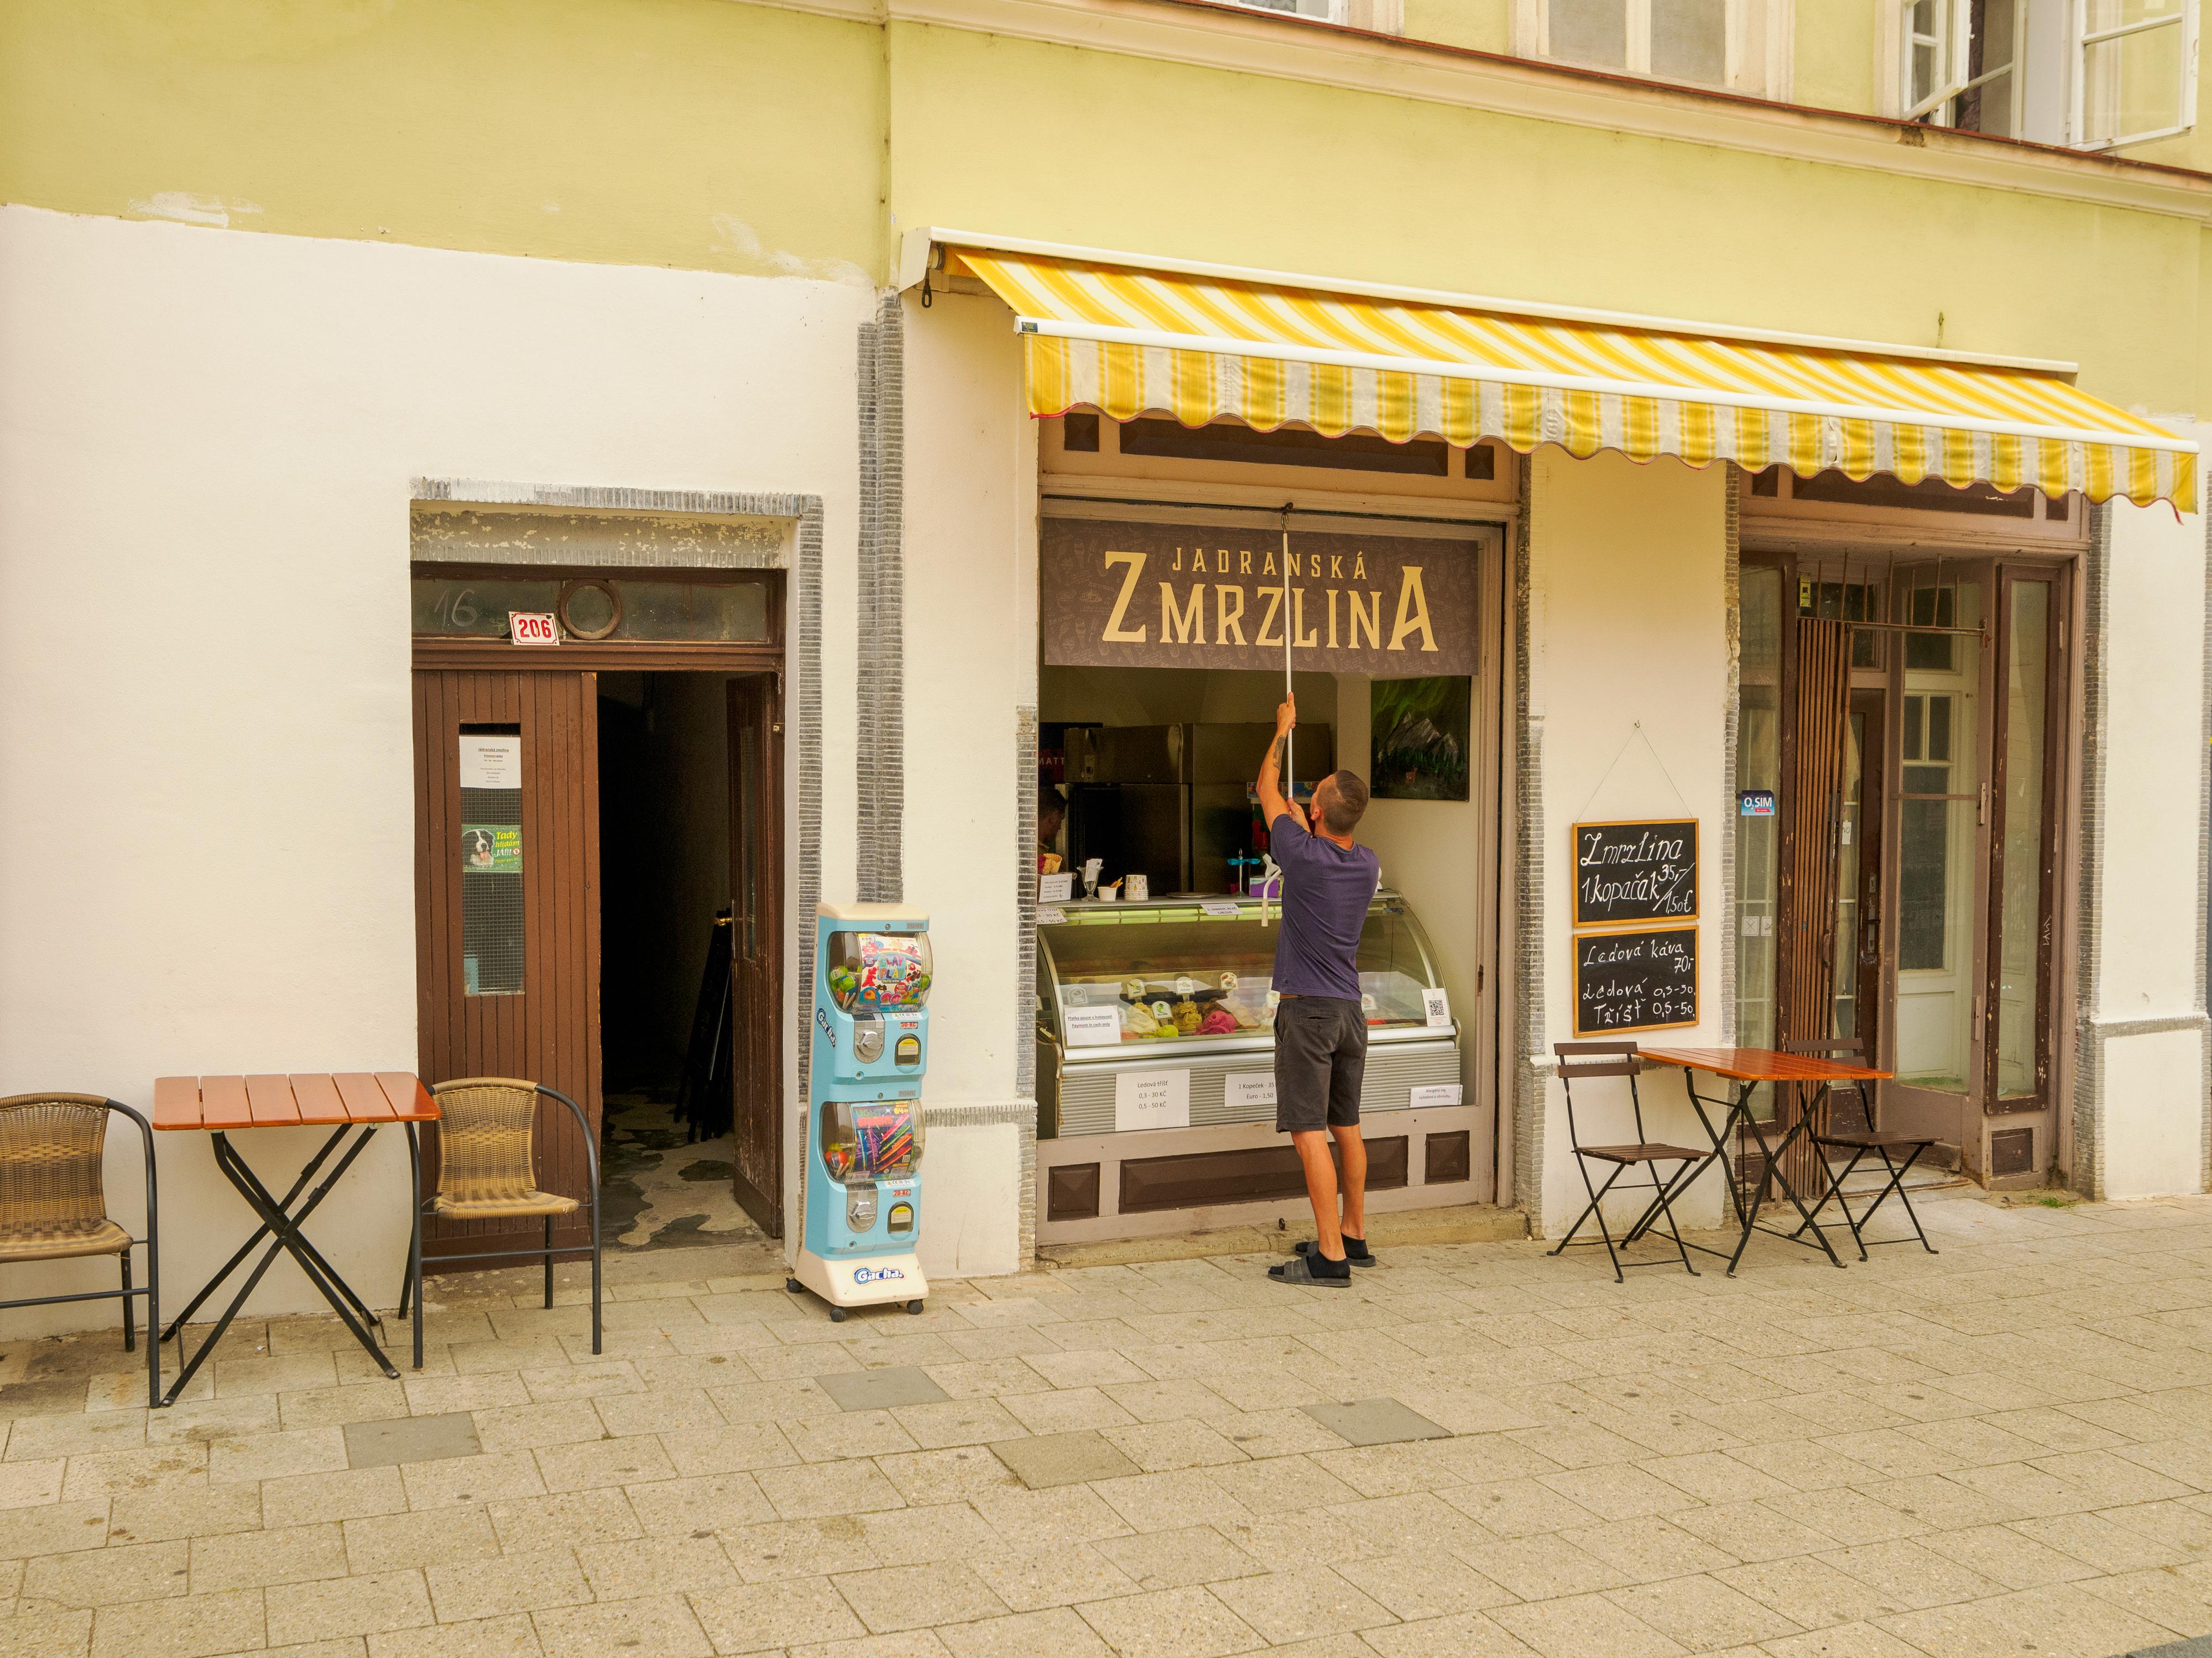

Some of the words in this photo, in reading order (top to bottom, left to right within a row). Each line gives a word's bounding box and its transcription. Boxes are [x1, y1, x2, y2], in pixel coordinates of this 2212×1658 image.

[1172, 547, 1367, 579] JADRANSKÁ
[435, 588, 478, 631] 16
[1102, 551, 1439, 651] ZMRZLINA
[518, 619, 552, 639] 206
[1755, 797, 1772, 807] SIM
[496, 831, 518, 840] Tady
[1580, 831, 1683, 866] Zmrzlina
[1582, 877, 1590, 903] 1
[880, 956, 904, 966] CLAY
[1583, 941, 1644, 966] Ledová
[1651, 939, 1684, 958] káva
[880, 969, 904, 979] PLAY
[1583, 977, 1648, 1000] Ledová
